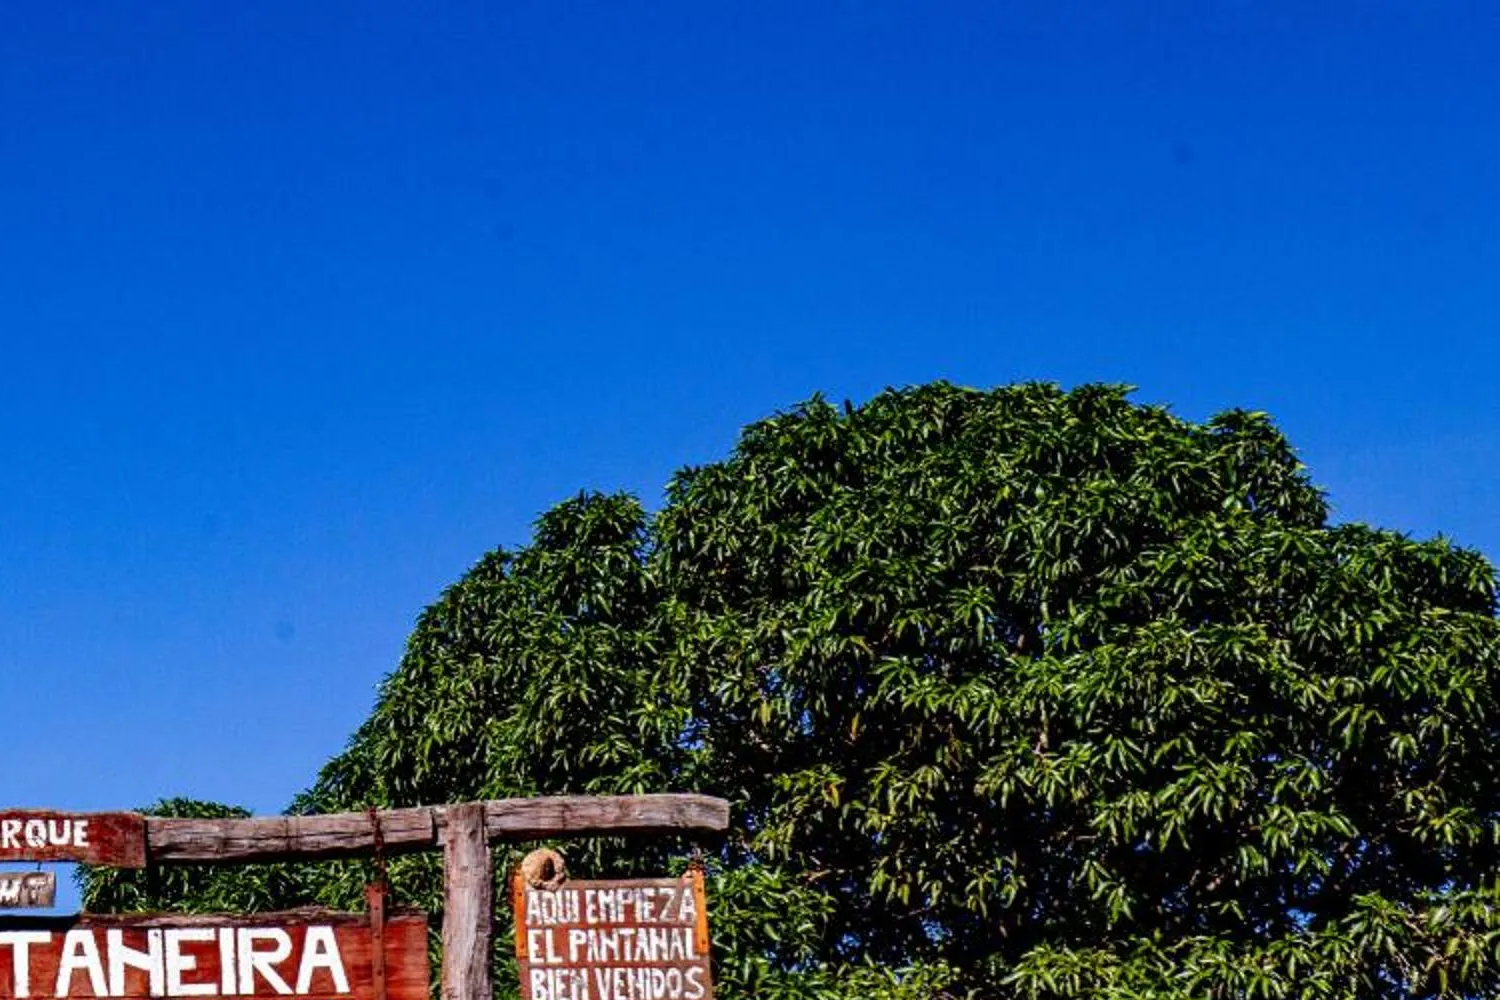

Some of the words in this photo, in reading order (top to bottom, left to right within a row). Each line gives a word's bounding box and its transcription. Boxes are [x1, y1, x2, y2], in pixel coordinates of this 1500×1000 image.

[525, 888, 579, 925] AQUI
[586, 887, 697, 924] EMPIEZA
[528, 929, 563, 964] EL
[569, 928, 701, 962] PANTANAL
